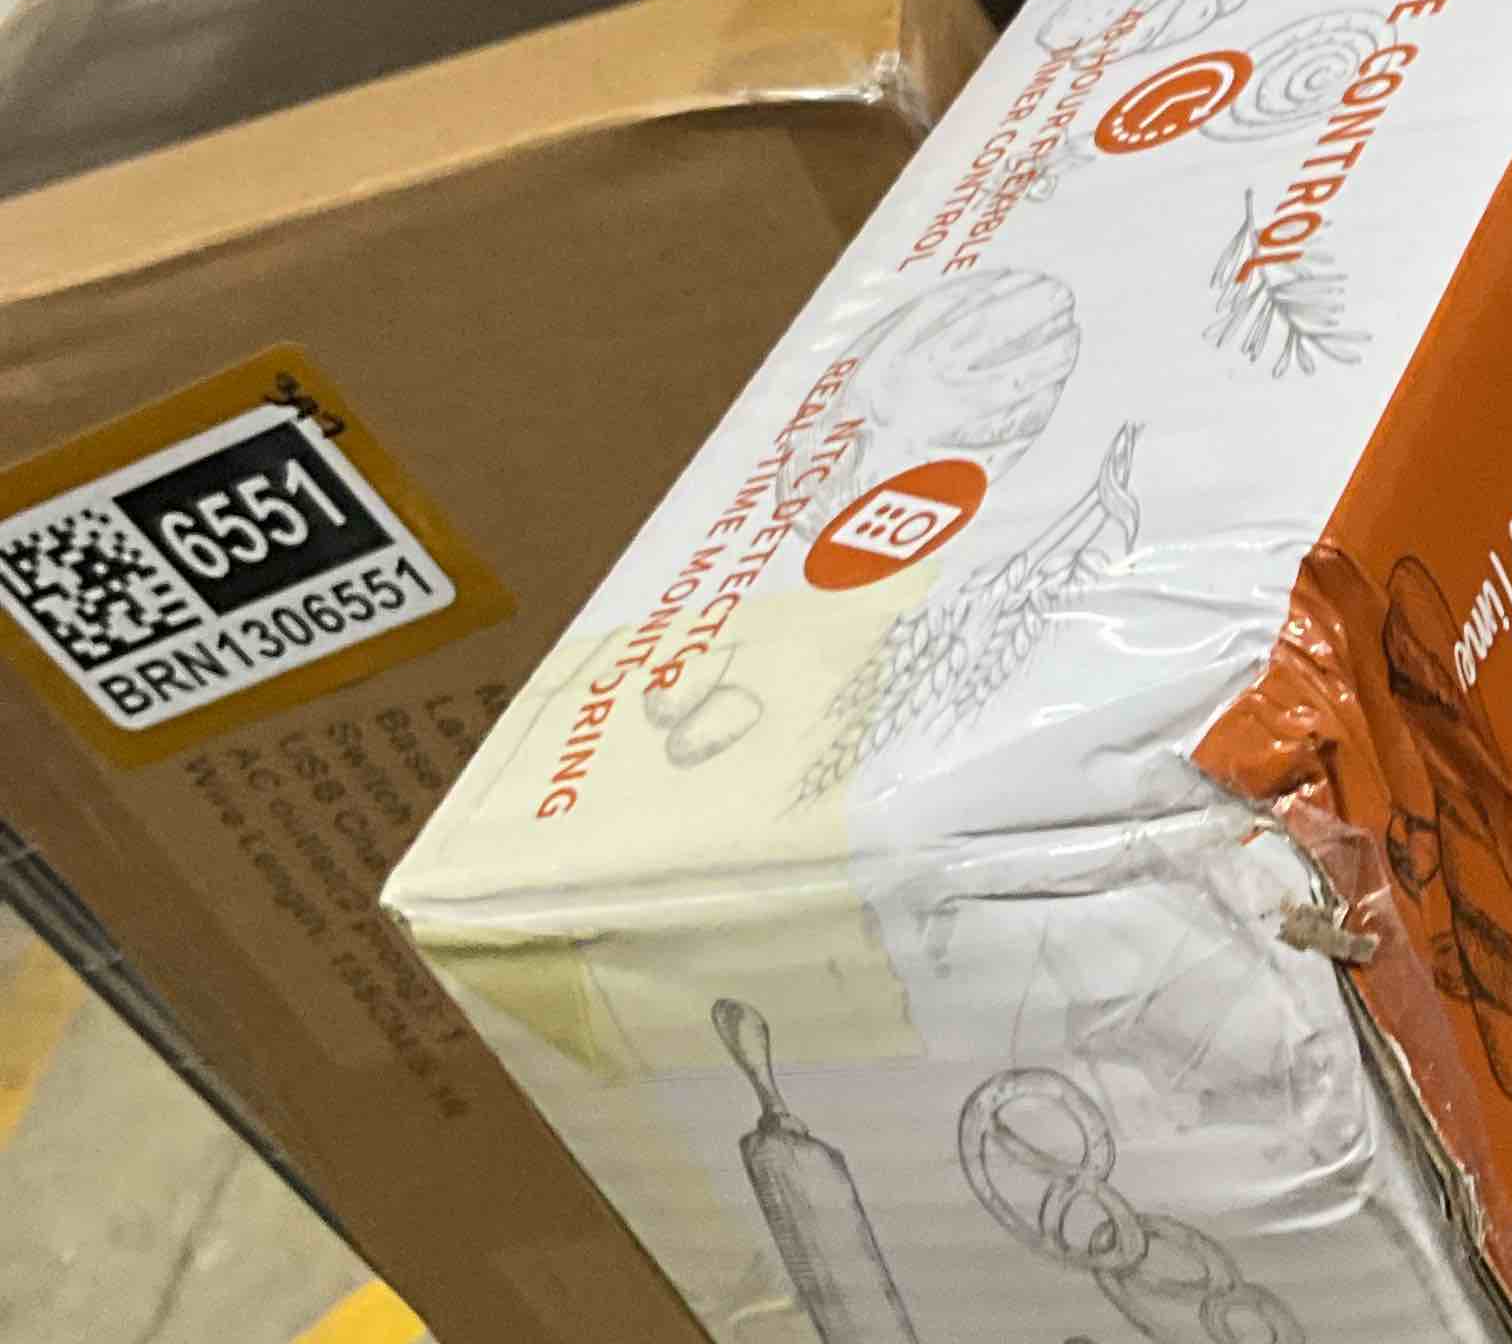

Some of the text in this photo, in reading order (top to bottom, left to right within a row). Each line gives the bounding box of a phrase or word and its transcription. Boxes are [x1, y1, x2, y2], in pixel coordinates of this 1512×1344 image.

[897, 129, 1018, 273] CONTROL
[942, 135, 1061, 275] FLEXIBLE
[1234, 42, 1420, 284] CONTROL
[160, 458, 347, 579] 6551
[536, 357, 859, 820] REAL-TIME MONITORING
[643, 418, 866, 695] NTC DETECTOR
[100, 556, 433, 716] BRN1306551
